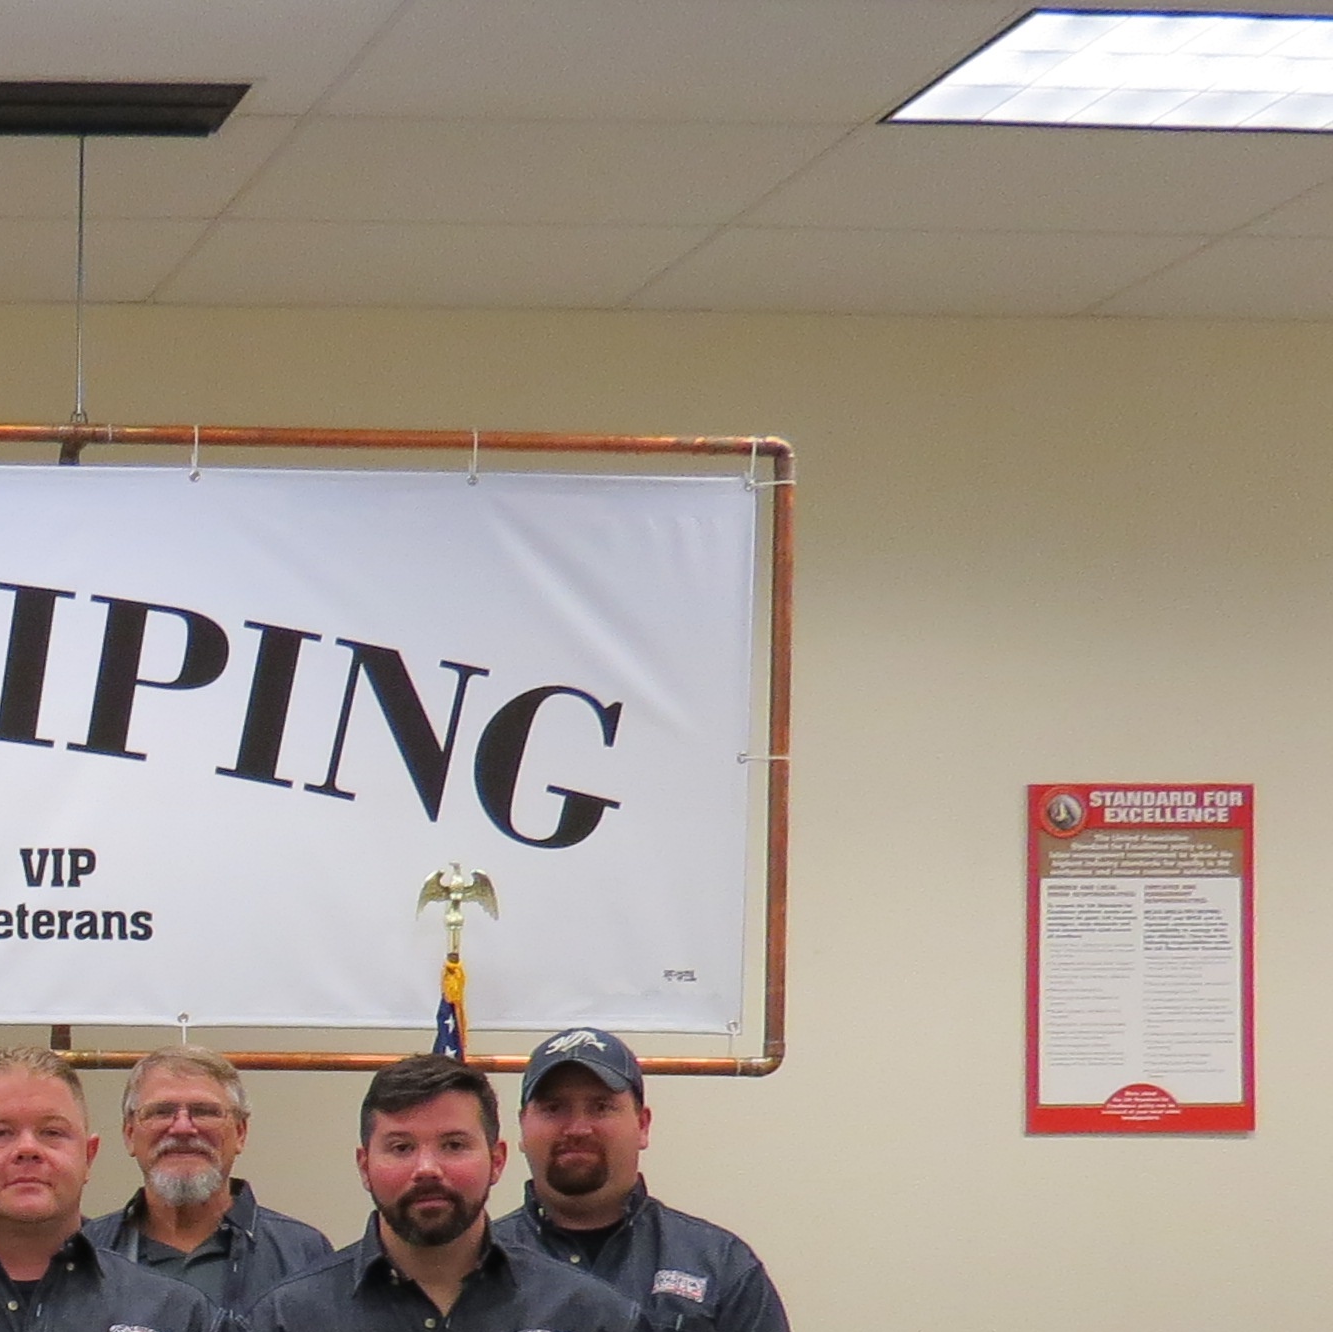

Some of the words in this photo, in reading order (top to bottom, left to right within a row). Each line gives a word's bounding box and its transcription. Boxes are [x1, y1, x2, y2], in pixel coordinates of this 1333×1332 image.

[1089, 791, 1197, 807] STANDARD
[1203, 791, 1243, 807] FOR
[1104, 808, 1229, 823] EXCELLENCE
[20, 847, 97, 888] VIP
